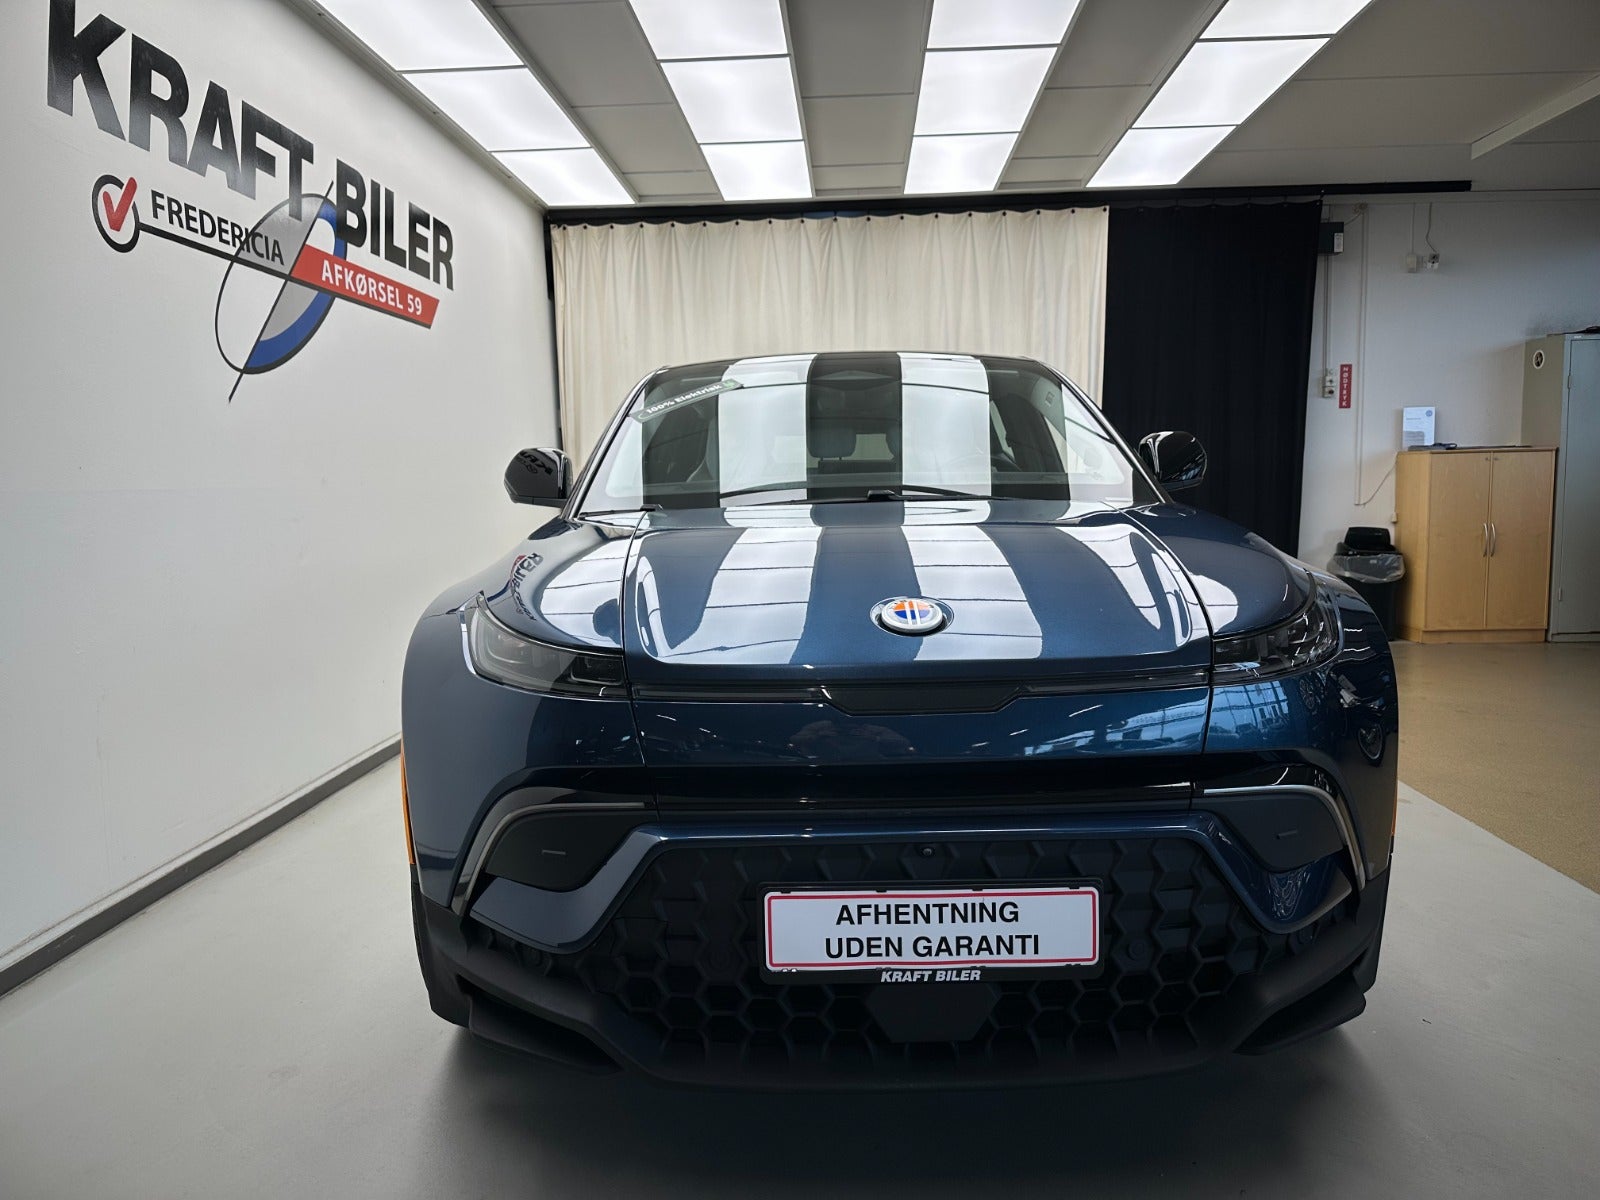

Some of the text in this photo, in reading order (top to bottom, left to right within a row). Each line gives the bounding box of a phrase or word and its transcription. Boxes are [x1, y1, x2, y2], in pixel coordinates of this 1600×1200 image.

[47, 0, 454, 291] KRAFT BILER
[150, 189, 284, 266] FREDERICIA
[321, 259, 423, 317] AFKØRSEL 59
[646, 400, 675, 414] 100%
[836, 901, 1019, 926] AFHENTNING
[825, 934, 1039, 959] UDEN GARANTI
[880, 970, 981, 983] KRAFT BILER
